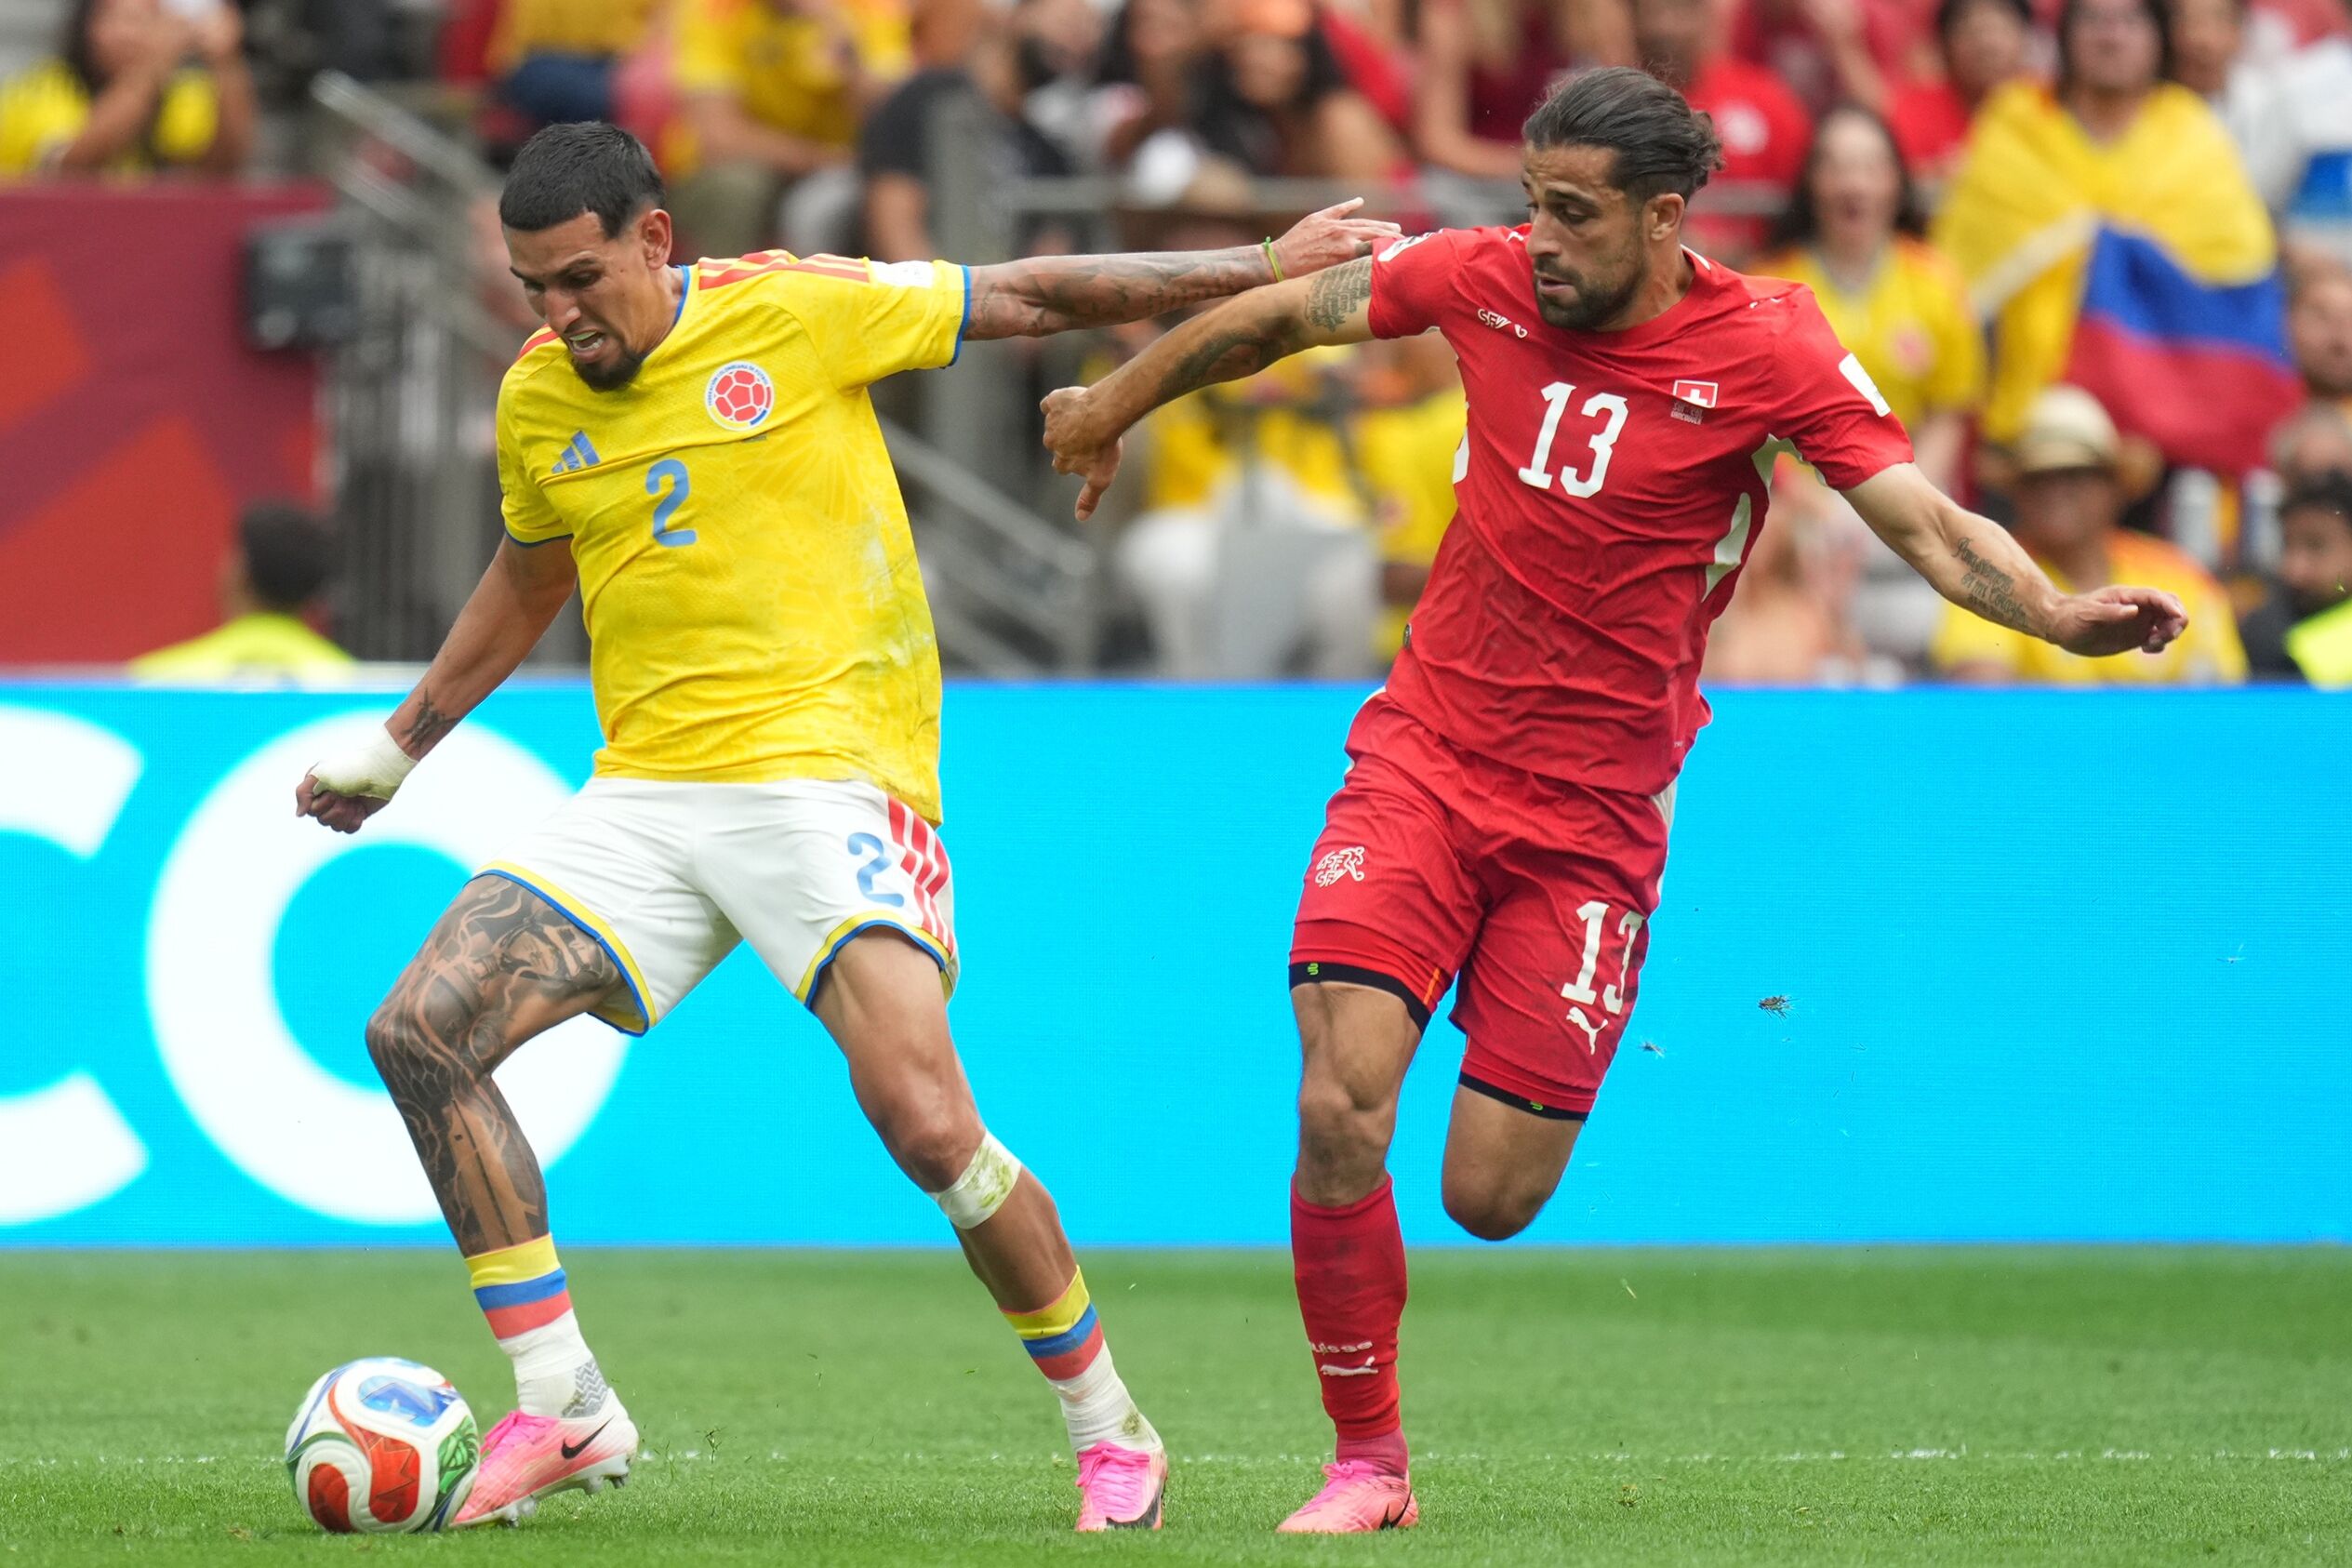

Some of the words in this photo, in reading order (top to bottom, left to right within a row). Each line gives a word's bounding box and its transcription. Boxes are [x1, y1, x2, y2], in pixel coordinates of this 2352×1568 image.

[1518, 380, 1628, 498] 13
[645, 458, 697, 548] 2
[847, 831, 905, 908] 2
